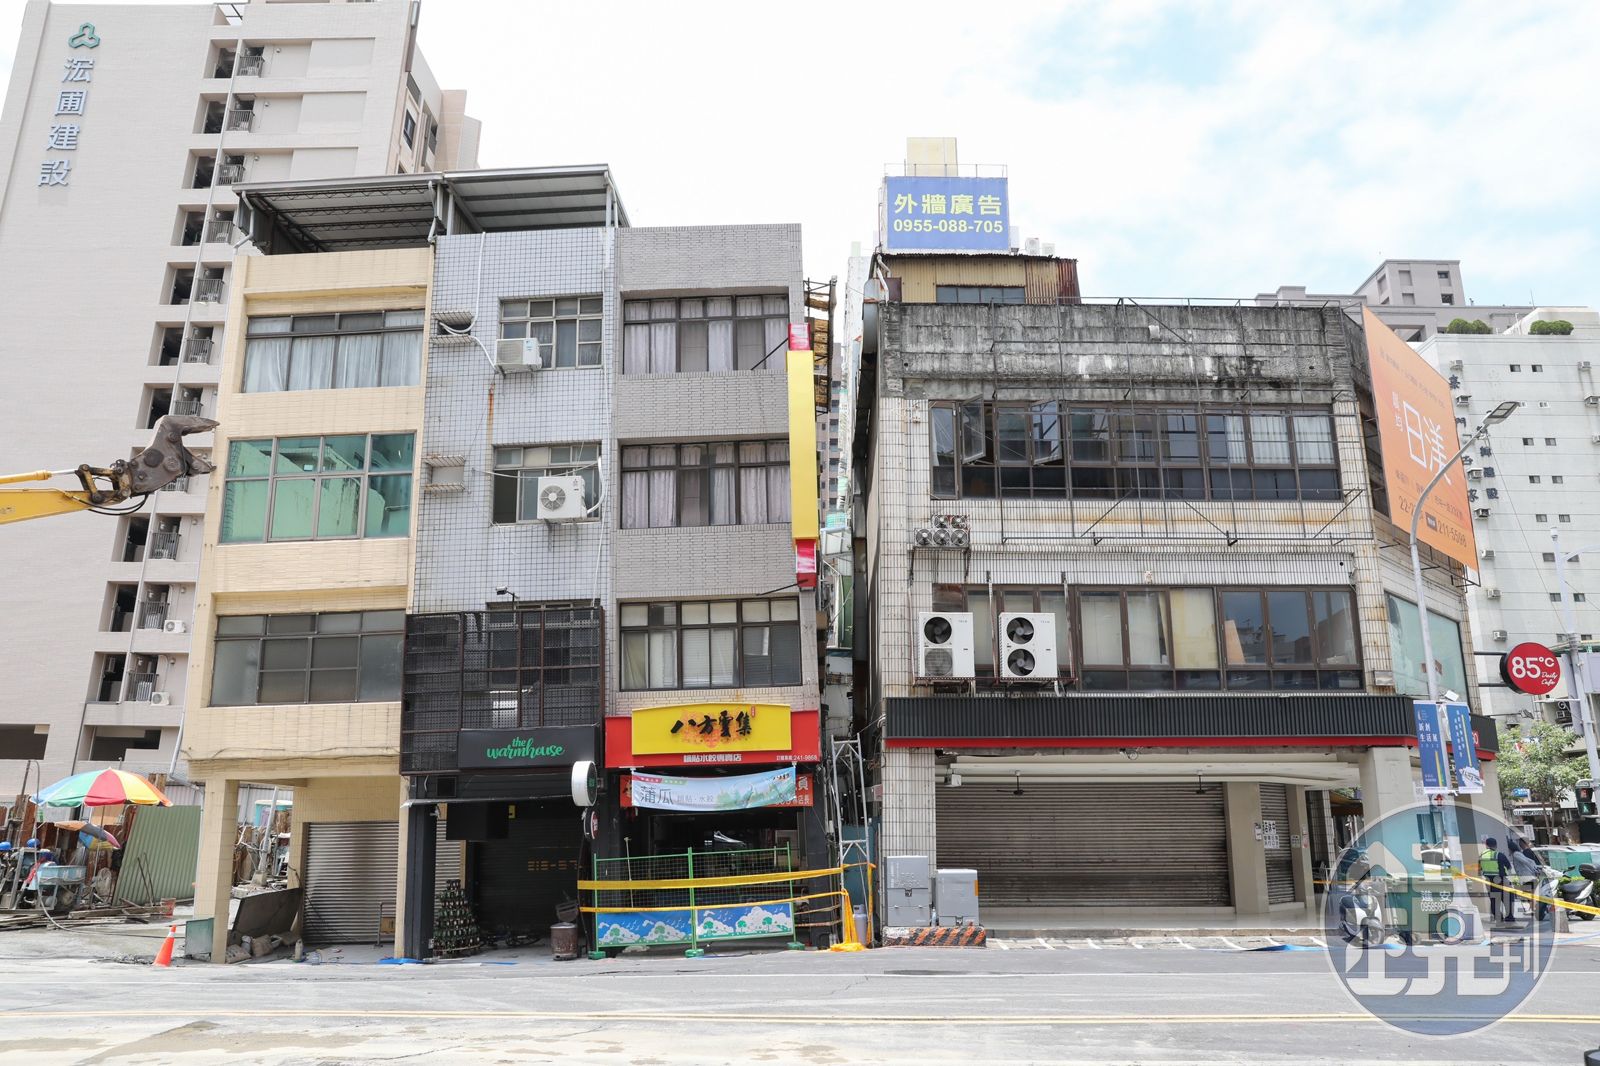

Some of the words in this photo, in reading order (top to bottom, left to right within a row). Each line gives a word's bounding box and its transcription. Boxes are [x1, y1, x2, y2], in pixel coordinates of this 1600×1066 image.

[894, 193, 1002, 215] 外牆廣告
[893, 219, 1004, 234] 0955-088-705
[1512, 656, 1555, 679] 85°C
[1541, 672, 1558, 680] Daily
[670, 710, 752, 737] 八方雲集
[486, 738, 565, 759] warmhouse
[512, 737, 527, 747] the
